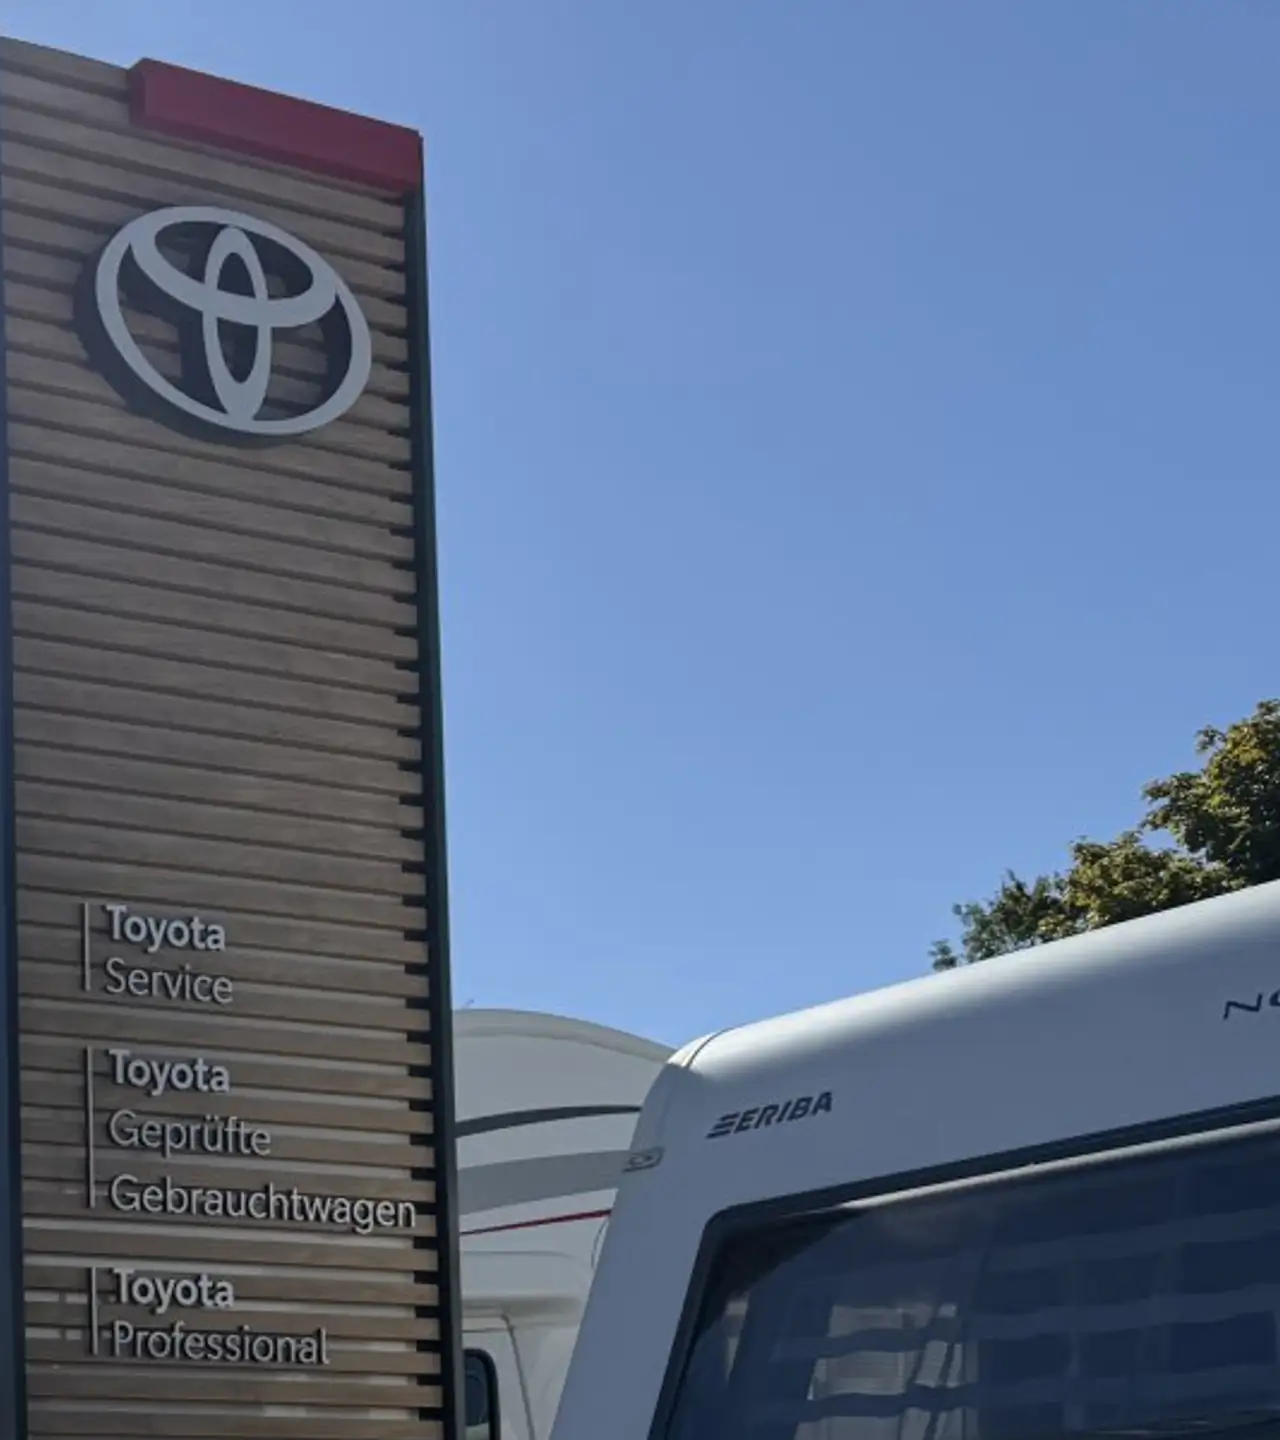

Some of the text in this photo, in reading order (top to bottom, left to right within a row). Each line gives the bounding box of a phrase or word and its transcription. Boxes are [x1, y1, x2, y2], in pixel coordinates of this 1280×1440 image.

[105, 903, 227, 953] Toyota
[105, 957, 234, 1004] Service
[108, 1048, 231, 1096] Toyota
[108, 1109, 272, 1158] Geprüfte
[730, 1090, 834, 1136] ERIBA
[110, 1173, 417, 1234] Gebrauchtwagen
[112, 1268, 236, 1314] Toyota
[112, 1320, 330, 1365] Professional
